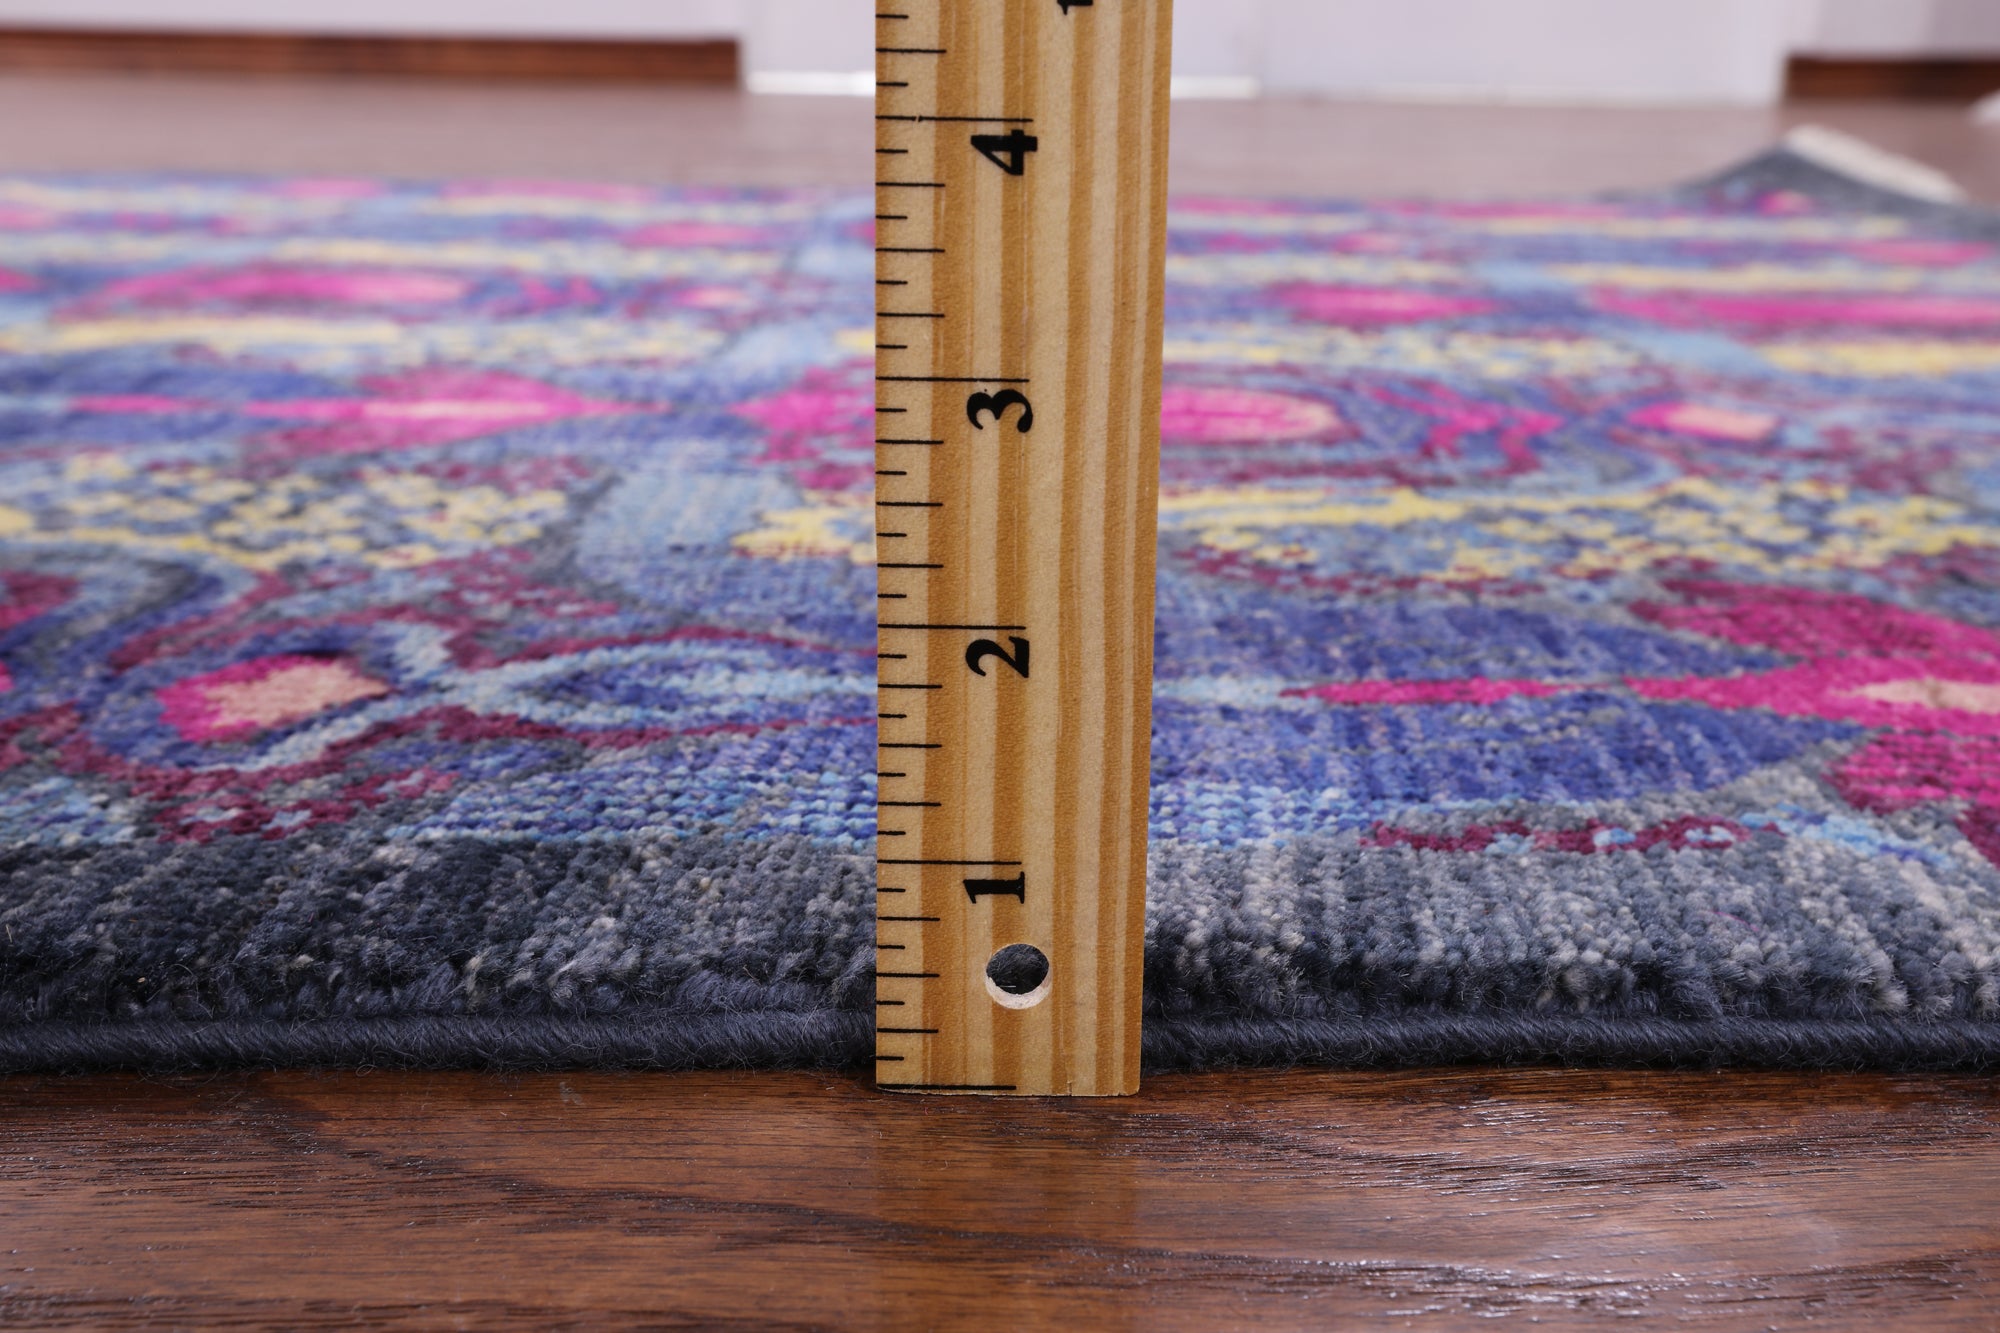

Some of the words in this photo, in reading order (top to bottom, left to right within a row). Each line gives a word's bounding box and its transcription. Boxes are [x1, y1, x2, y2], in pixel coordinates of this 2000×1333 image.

[970, 129, 1038, 176] 4
[966, 388, 1034, 433] 3
[965, 635, 1030, 679] 2
[962, 871, 1025, 904] 1
